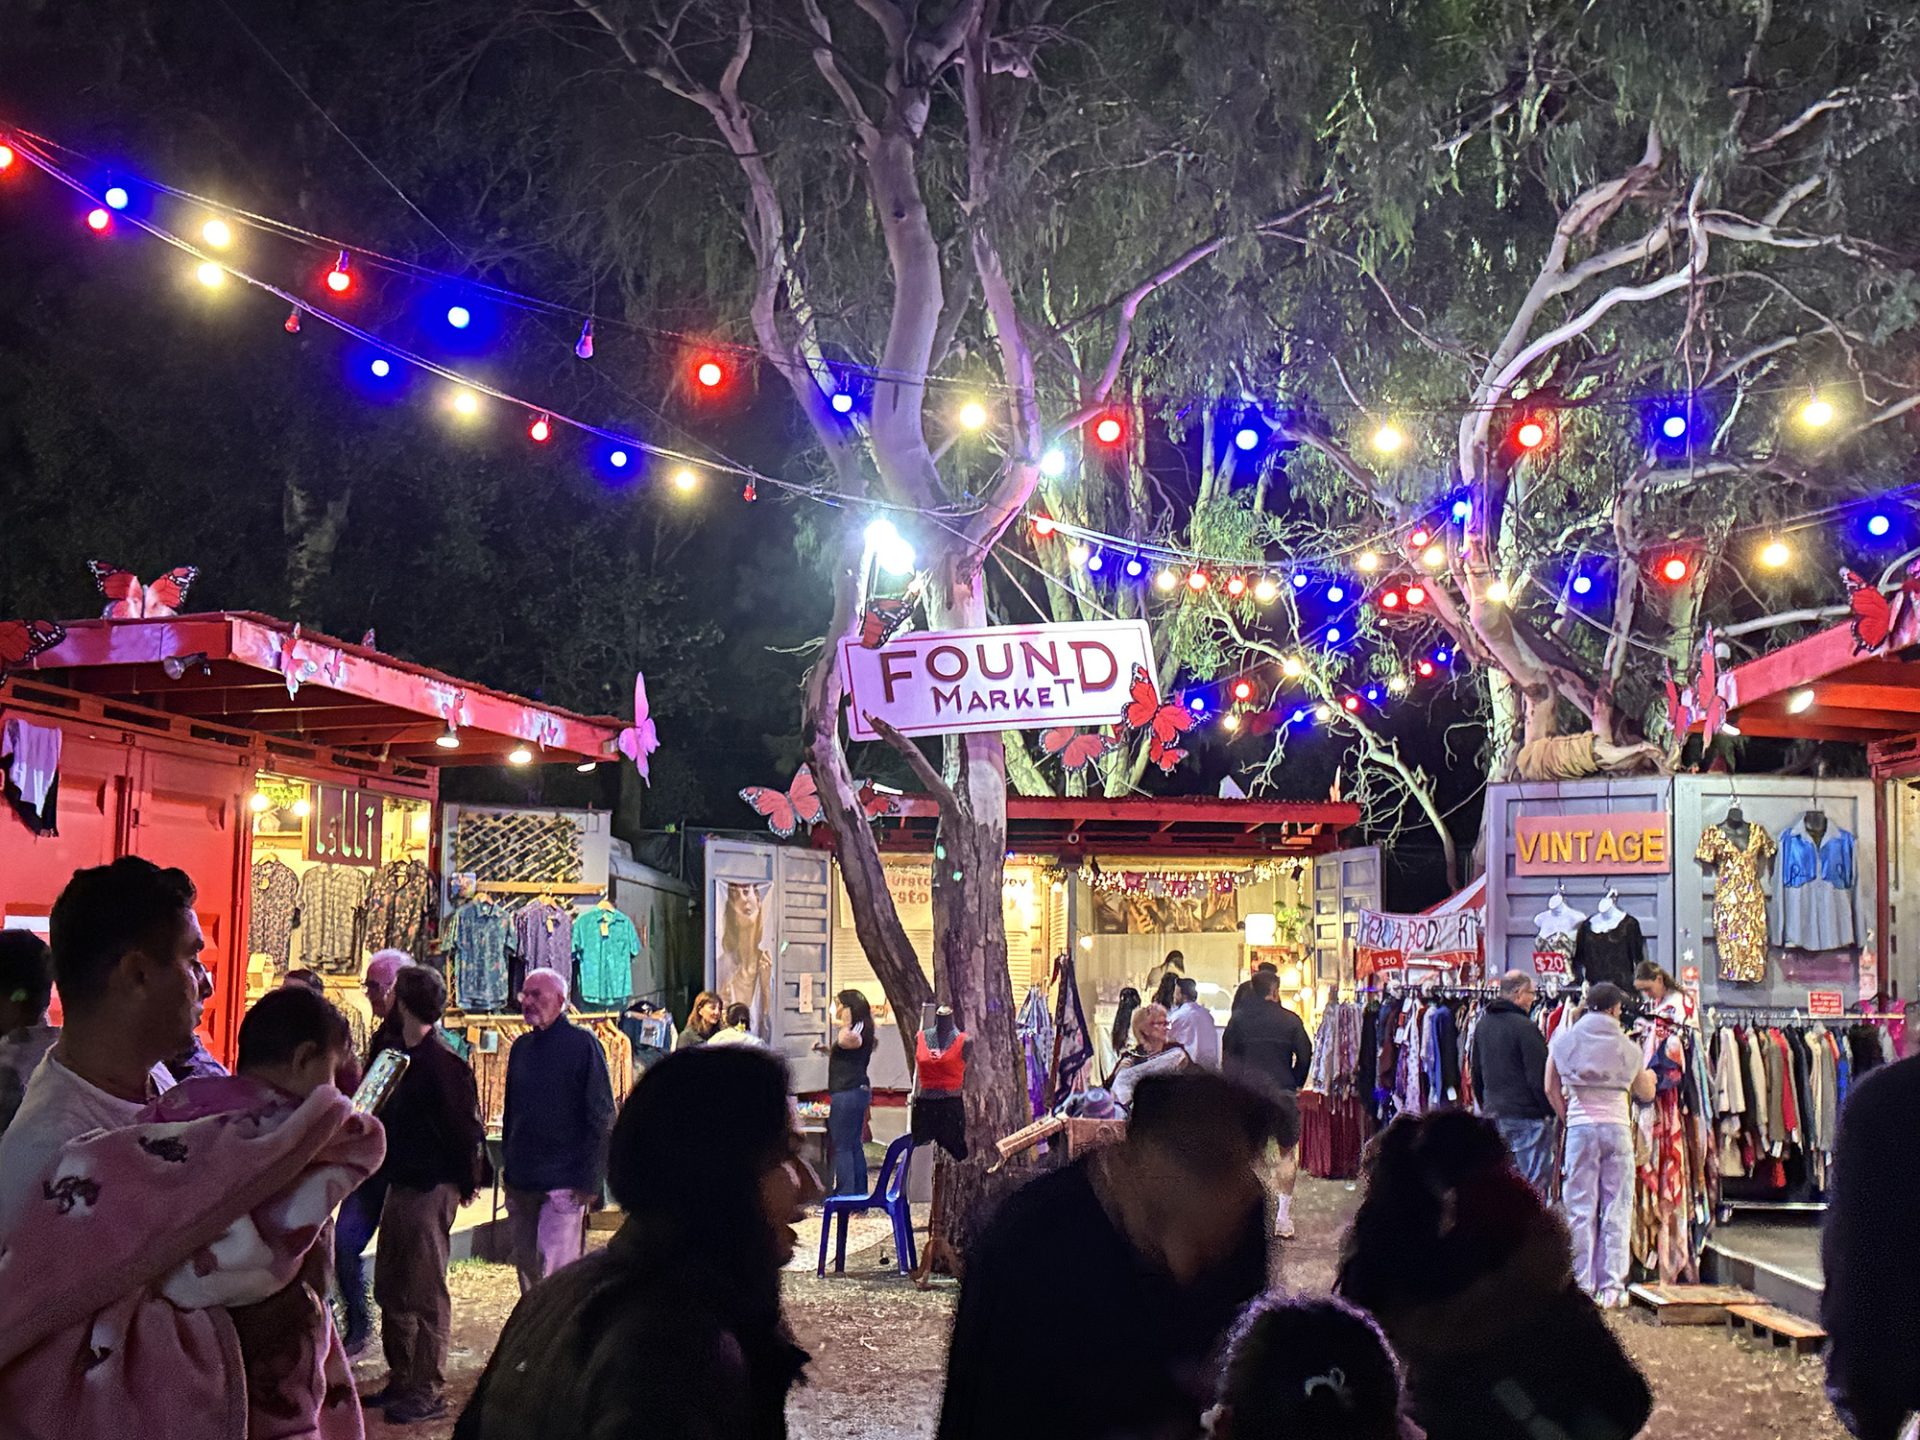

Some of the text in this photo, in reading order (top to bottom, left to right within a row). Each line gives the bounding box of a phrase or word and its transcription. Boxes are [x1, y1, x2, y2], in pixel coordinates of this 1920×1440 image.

[880, 641, 1118, 703] FOUND
[930, 678, 1074, 715] MARKET
[1517, 828, 1664, 863] VINTAGE
[1448, 912, 1479, 948] RT
[1376, 956, 1397, 968] $20
[1535, 955, 1564, 971] $20
